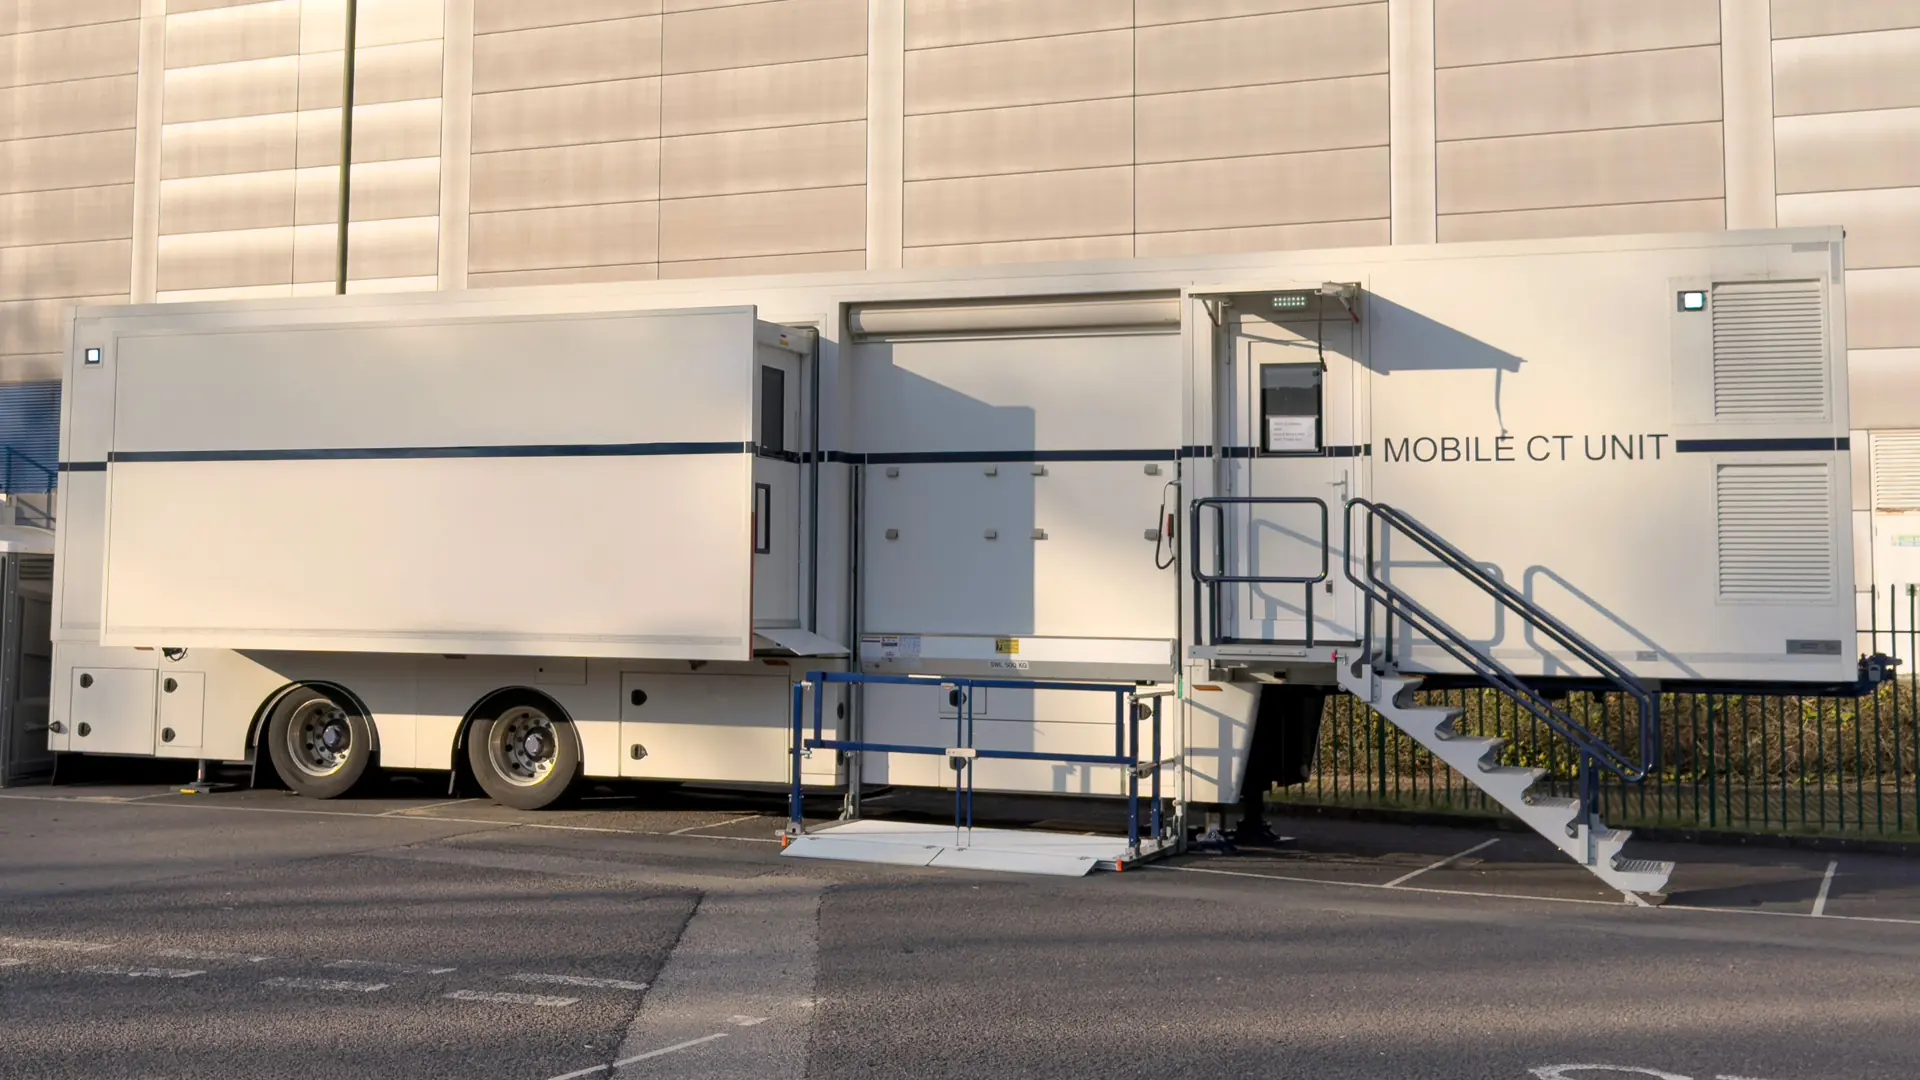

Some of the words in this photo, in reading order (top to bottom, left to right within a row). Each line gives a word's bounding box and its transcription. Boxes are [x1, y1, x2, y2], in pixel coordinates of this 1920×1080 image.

[1384, 437, 1515, 462] MOBILE
[1527, 435, 1573, 461] CT
[1585, 434, 1669, 461] UNIT
